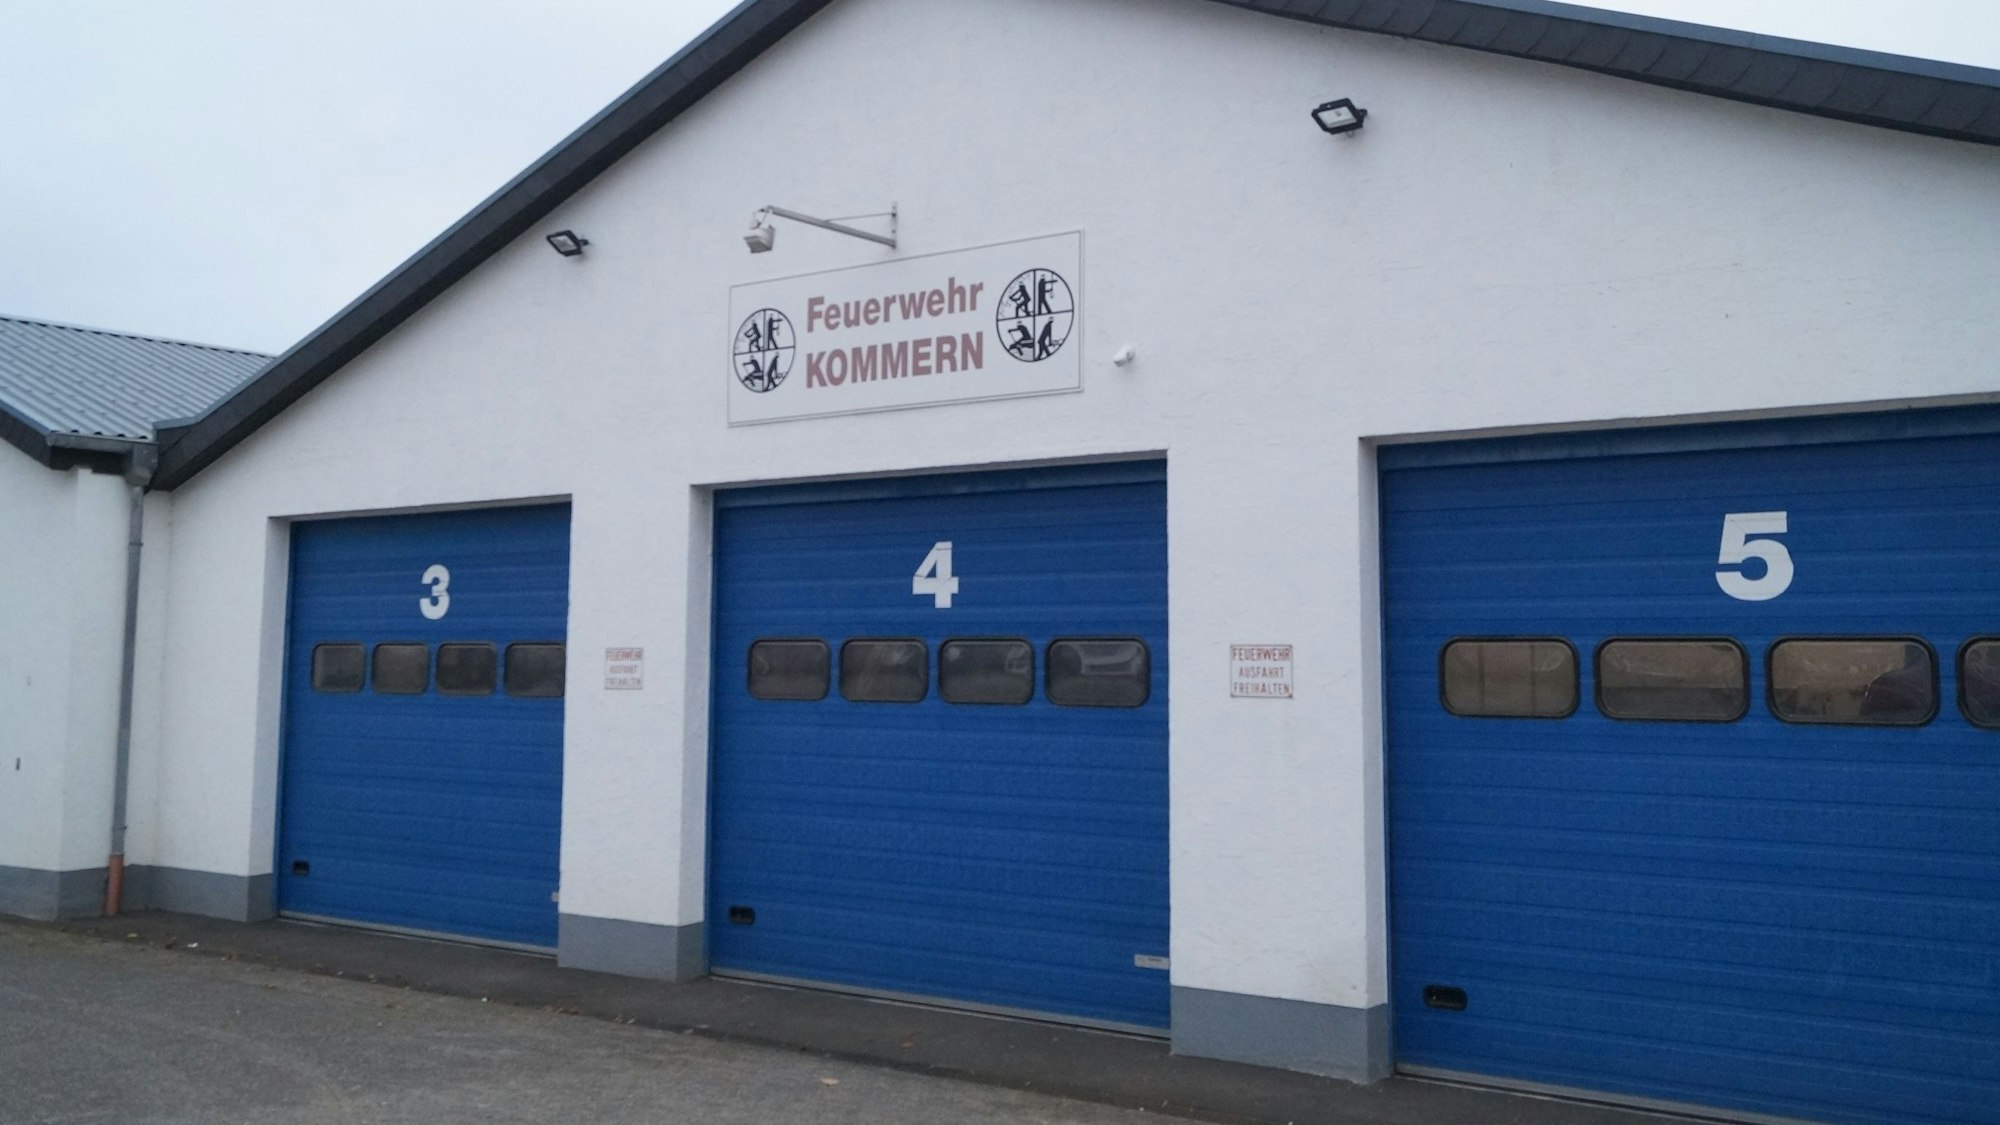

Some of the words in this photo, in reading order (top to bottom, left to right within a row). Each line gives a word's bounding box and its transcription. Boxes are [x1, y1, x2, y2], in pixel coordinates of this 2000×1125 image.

[806, 276, 984, 333] Feuerwehr
[806, 331, 984, 389] KOMMERN
[912, 540, 960, 609] 4
[1714, 510, 1794, 602] 5
[419, 564, 451, 621] 3
[1232, 647, 1291, 661] FEUERWEHR
[1239, 666, 1284, 679] AUSFAHRT
[1233, 682, 1290, 696] FREIHALTEN
